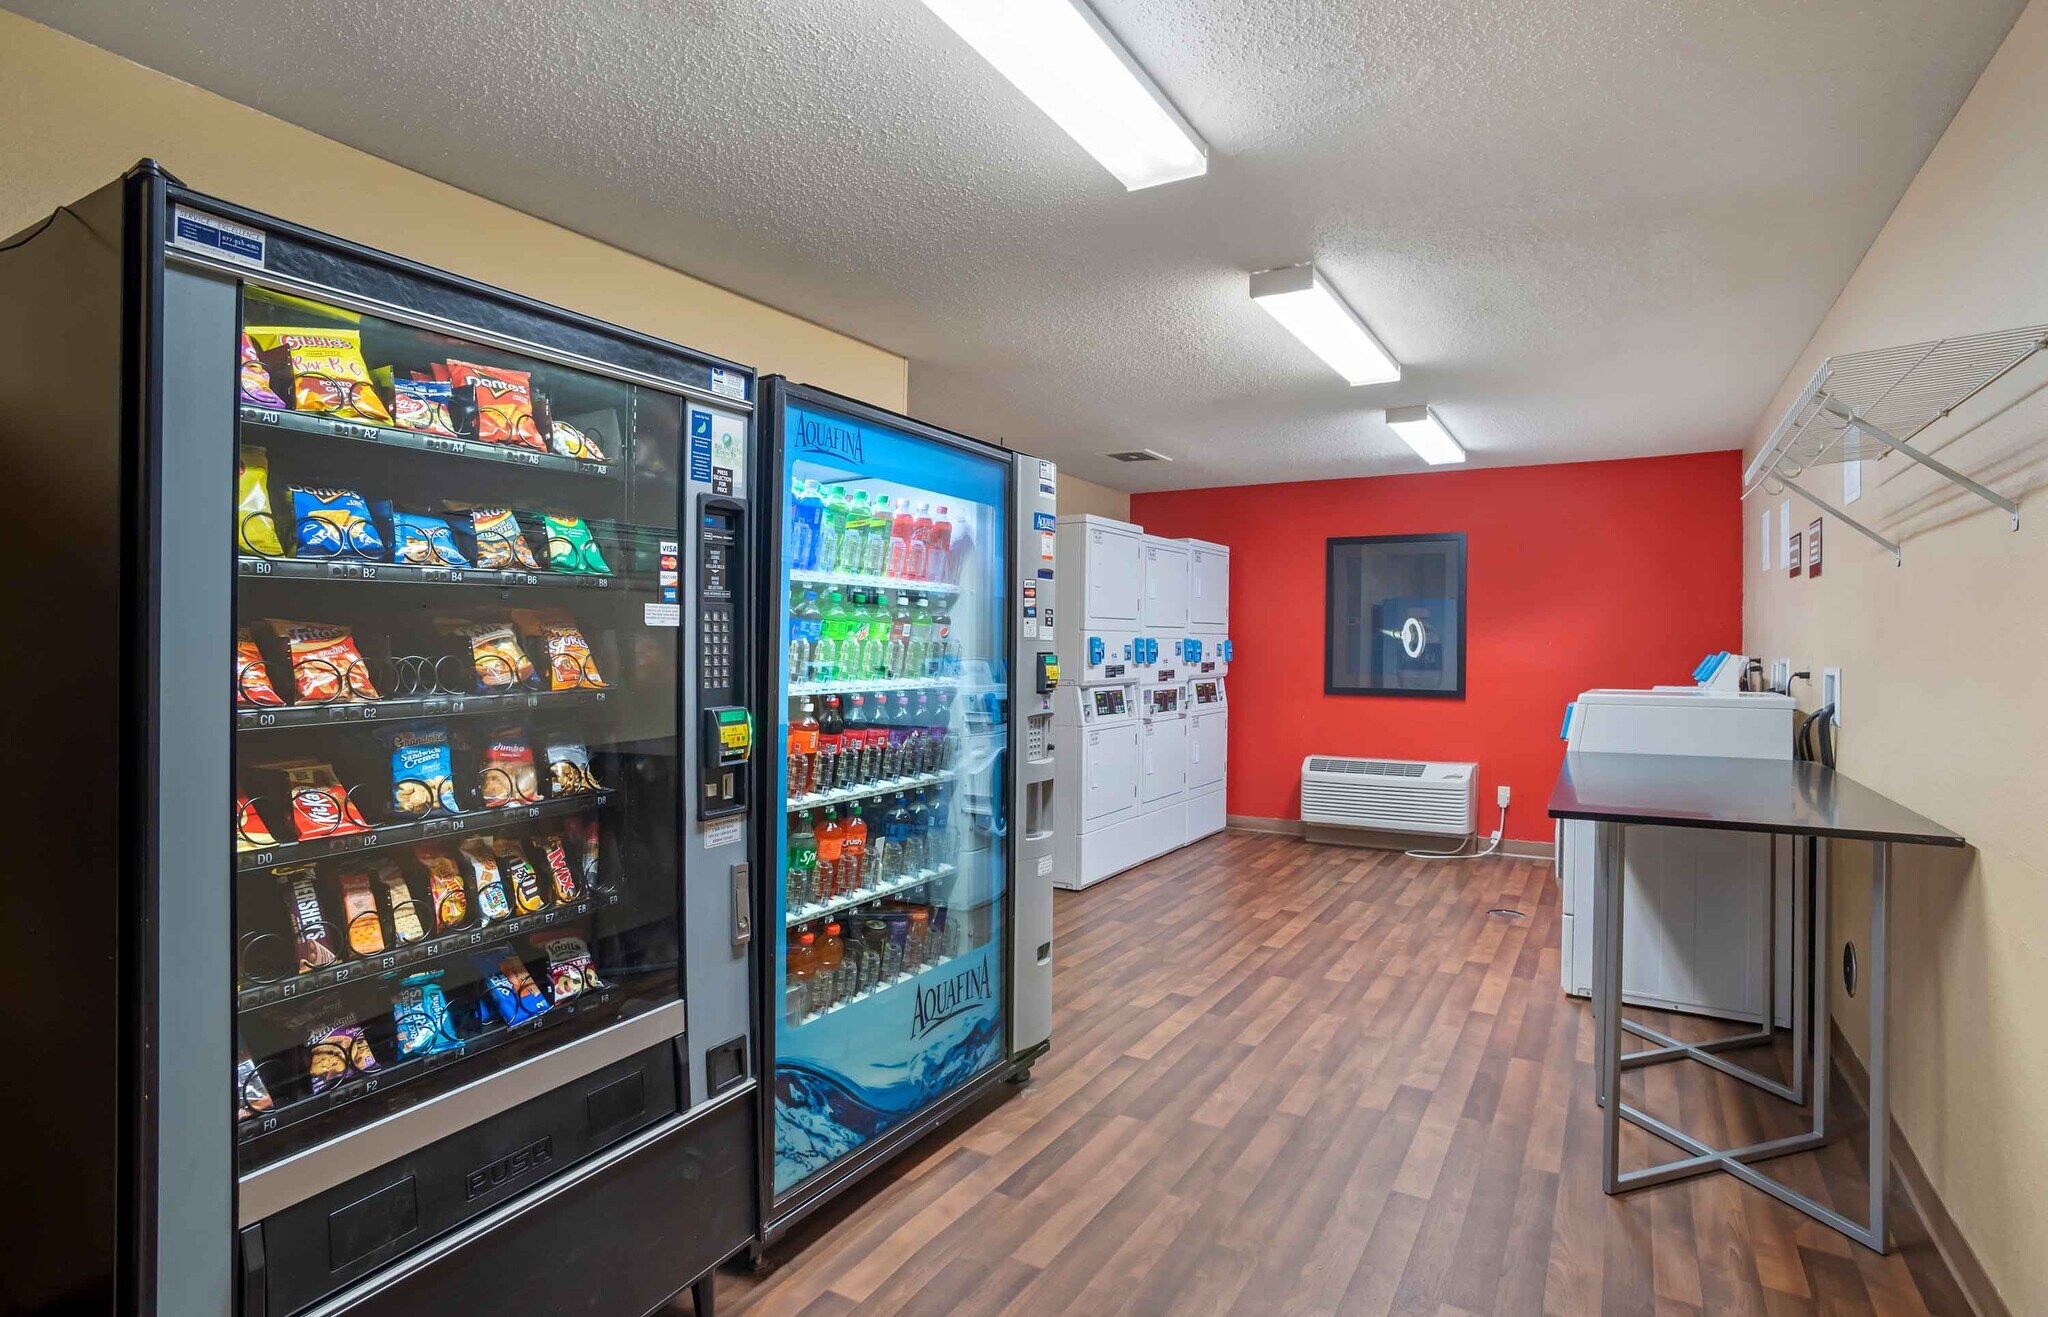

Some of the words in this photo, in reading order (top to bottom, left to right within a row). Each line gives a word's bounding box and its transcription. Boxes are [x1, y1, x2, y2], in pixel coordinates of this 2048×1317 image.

[180, 210, 210, 225] SERVICE
[217, 223, 261, 241] EXCELLENCE
[466, 376, 527, 395] Doritos
[263, 412, 278, 424] A0
[363, 428, 377, 440] A2
[794, 411, 865, 465] AQUAFINA
[452, 443, 463, 453] A4
[529, 455, 539, 465] A6
[597, 466, 607, 475] A8
[256, 563, 272, 574] B0
[363, 568, 376, 578] B2
[451, 571, 463, 582] B4
[527, 575, 538, 585] B6
[599, 578, 608, 587] B8
[596, 693, 606, 702] C8
[453, 702, 464, 712] C4
[364, 708, 377, 718] C2
[260, 714, 275, 725] C0
[493, 742, 525, 752] Jumbo
[401, 747, 441, 762] Sandwich
[404, 753, 440, 769] Cremes
[597, 796, 607, 805] D8
[529, 807, 539, 817] D6
[453, 820, 464, 830] D4
[364, 835, 377, 846] D2
[842, 837, 862, 847] Crush
[257, 853, 273, 864] D0
[292, 879, 326, 941] HERSHEY'S
[577, 905, 587, 914] E8
[545, 913, 555, 922] E7
[509, 923, 519, 933] E6
[471, 933, 482, 944] E5
[427, 945, 438, 956] E4
[383, 957, 395, 968] E3
[336, 970, 349, 981] E2
[284, 984, 296, 996] E1
[910, 952, 993, 1041] AQUAFINA
[533, 1019, 543, 1029] F6
[455, 1047, 465, 1058] F4
[366, 1080, 378, 1092] F2
[264, 1117, 277, 1130] F0
[472, 1142, 551, 1198] PUSH
